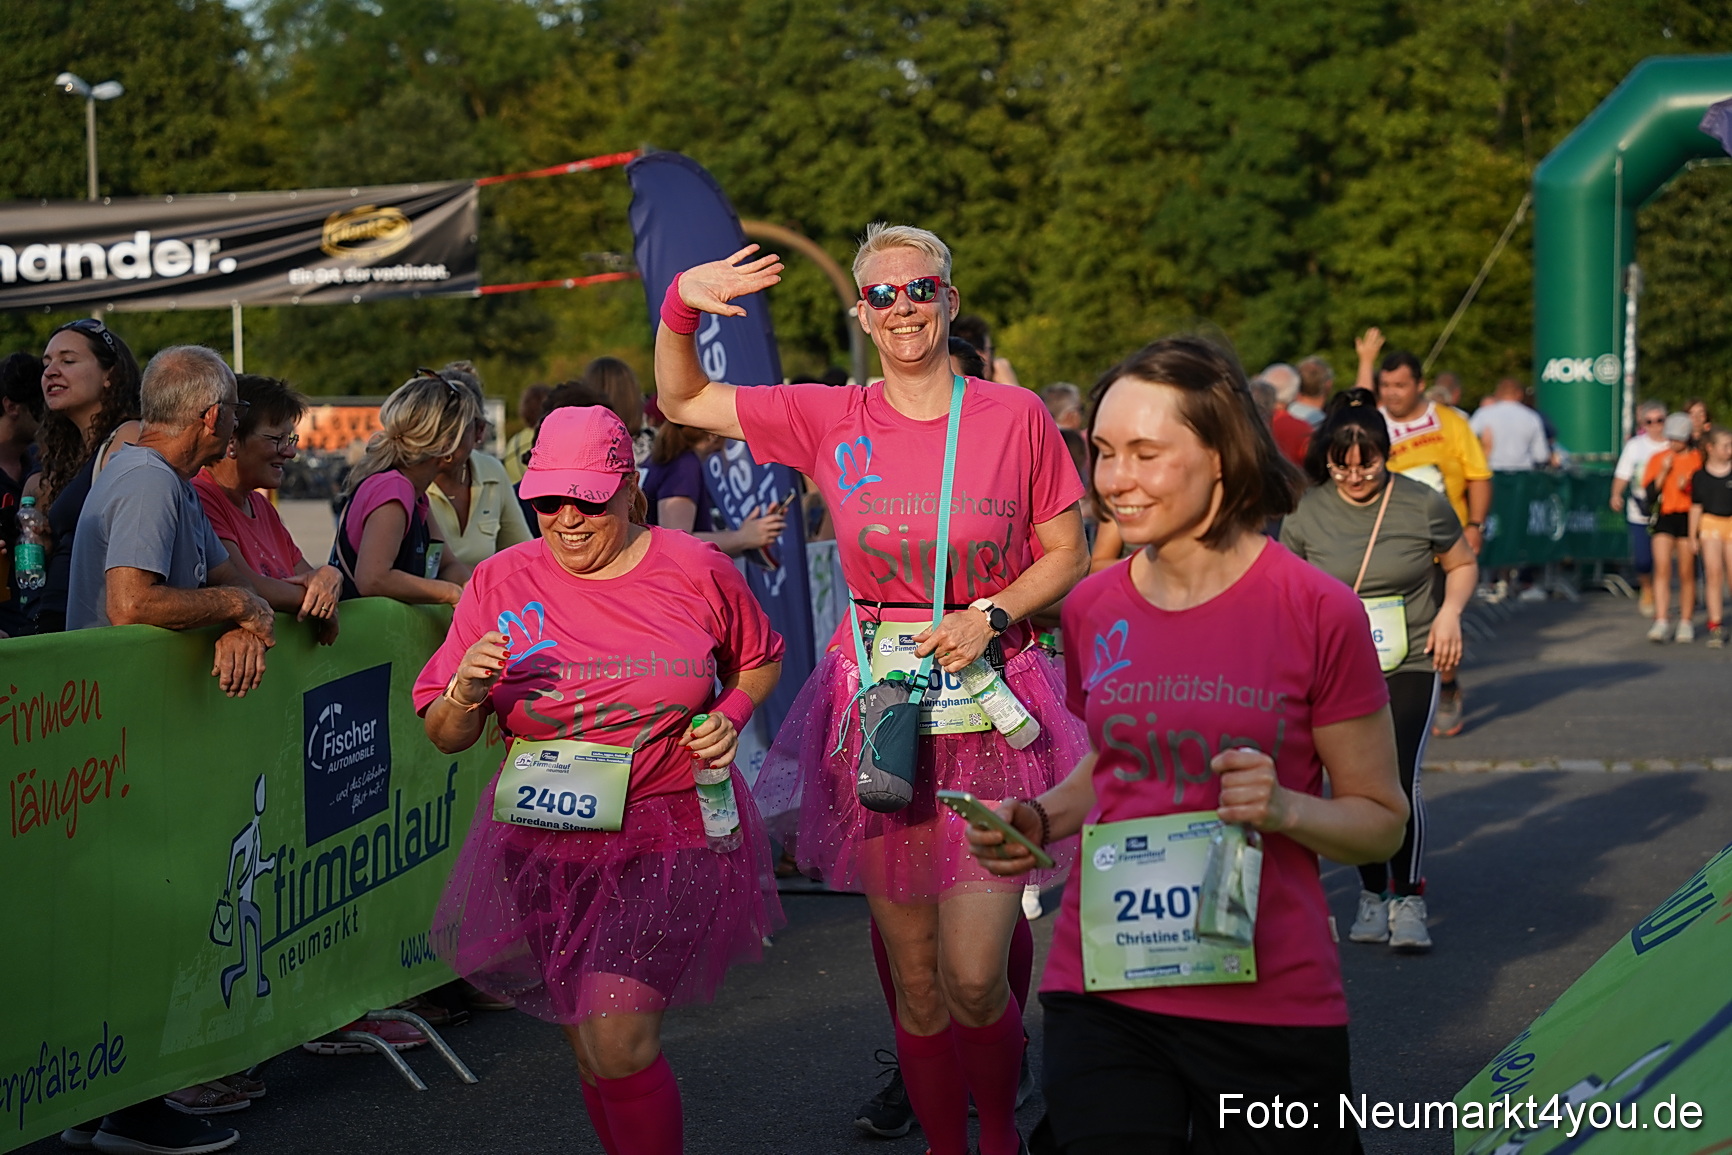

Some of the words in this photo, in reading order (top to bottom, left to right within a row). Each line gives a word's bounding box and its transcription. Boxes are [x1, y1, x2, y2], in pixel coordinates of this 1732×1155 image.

[1541, 357, 1594, 383] AOK
[857, 490, 1017, 519] Sanitäshaus
[527, 650, 715, 680] Sanitätshaus
[1100, 674, 1289, 714] Sanitätshaus
[522, 688, 691, 753] Sipp
[322, 718, 378, 761] Fischer
[327, 744, 376, 775] AUTOMOBILE
[531, 759, 572, 770] Firmenlauf
[10, 726, 131, 839] länger!
[516, 784, 598, 819] 2403
[509, 813, 560, 830] Loredana
[274, 761, 458, 937] firmenlauf
[278, 904, 359, 978] neumarkt
[1116, 930, 1179, 947] Christine
[0, 1020, 127, 1131] rpfalz.de
